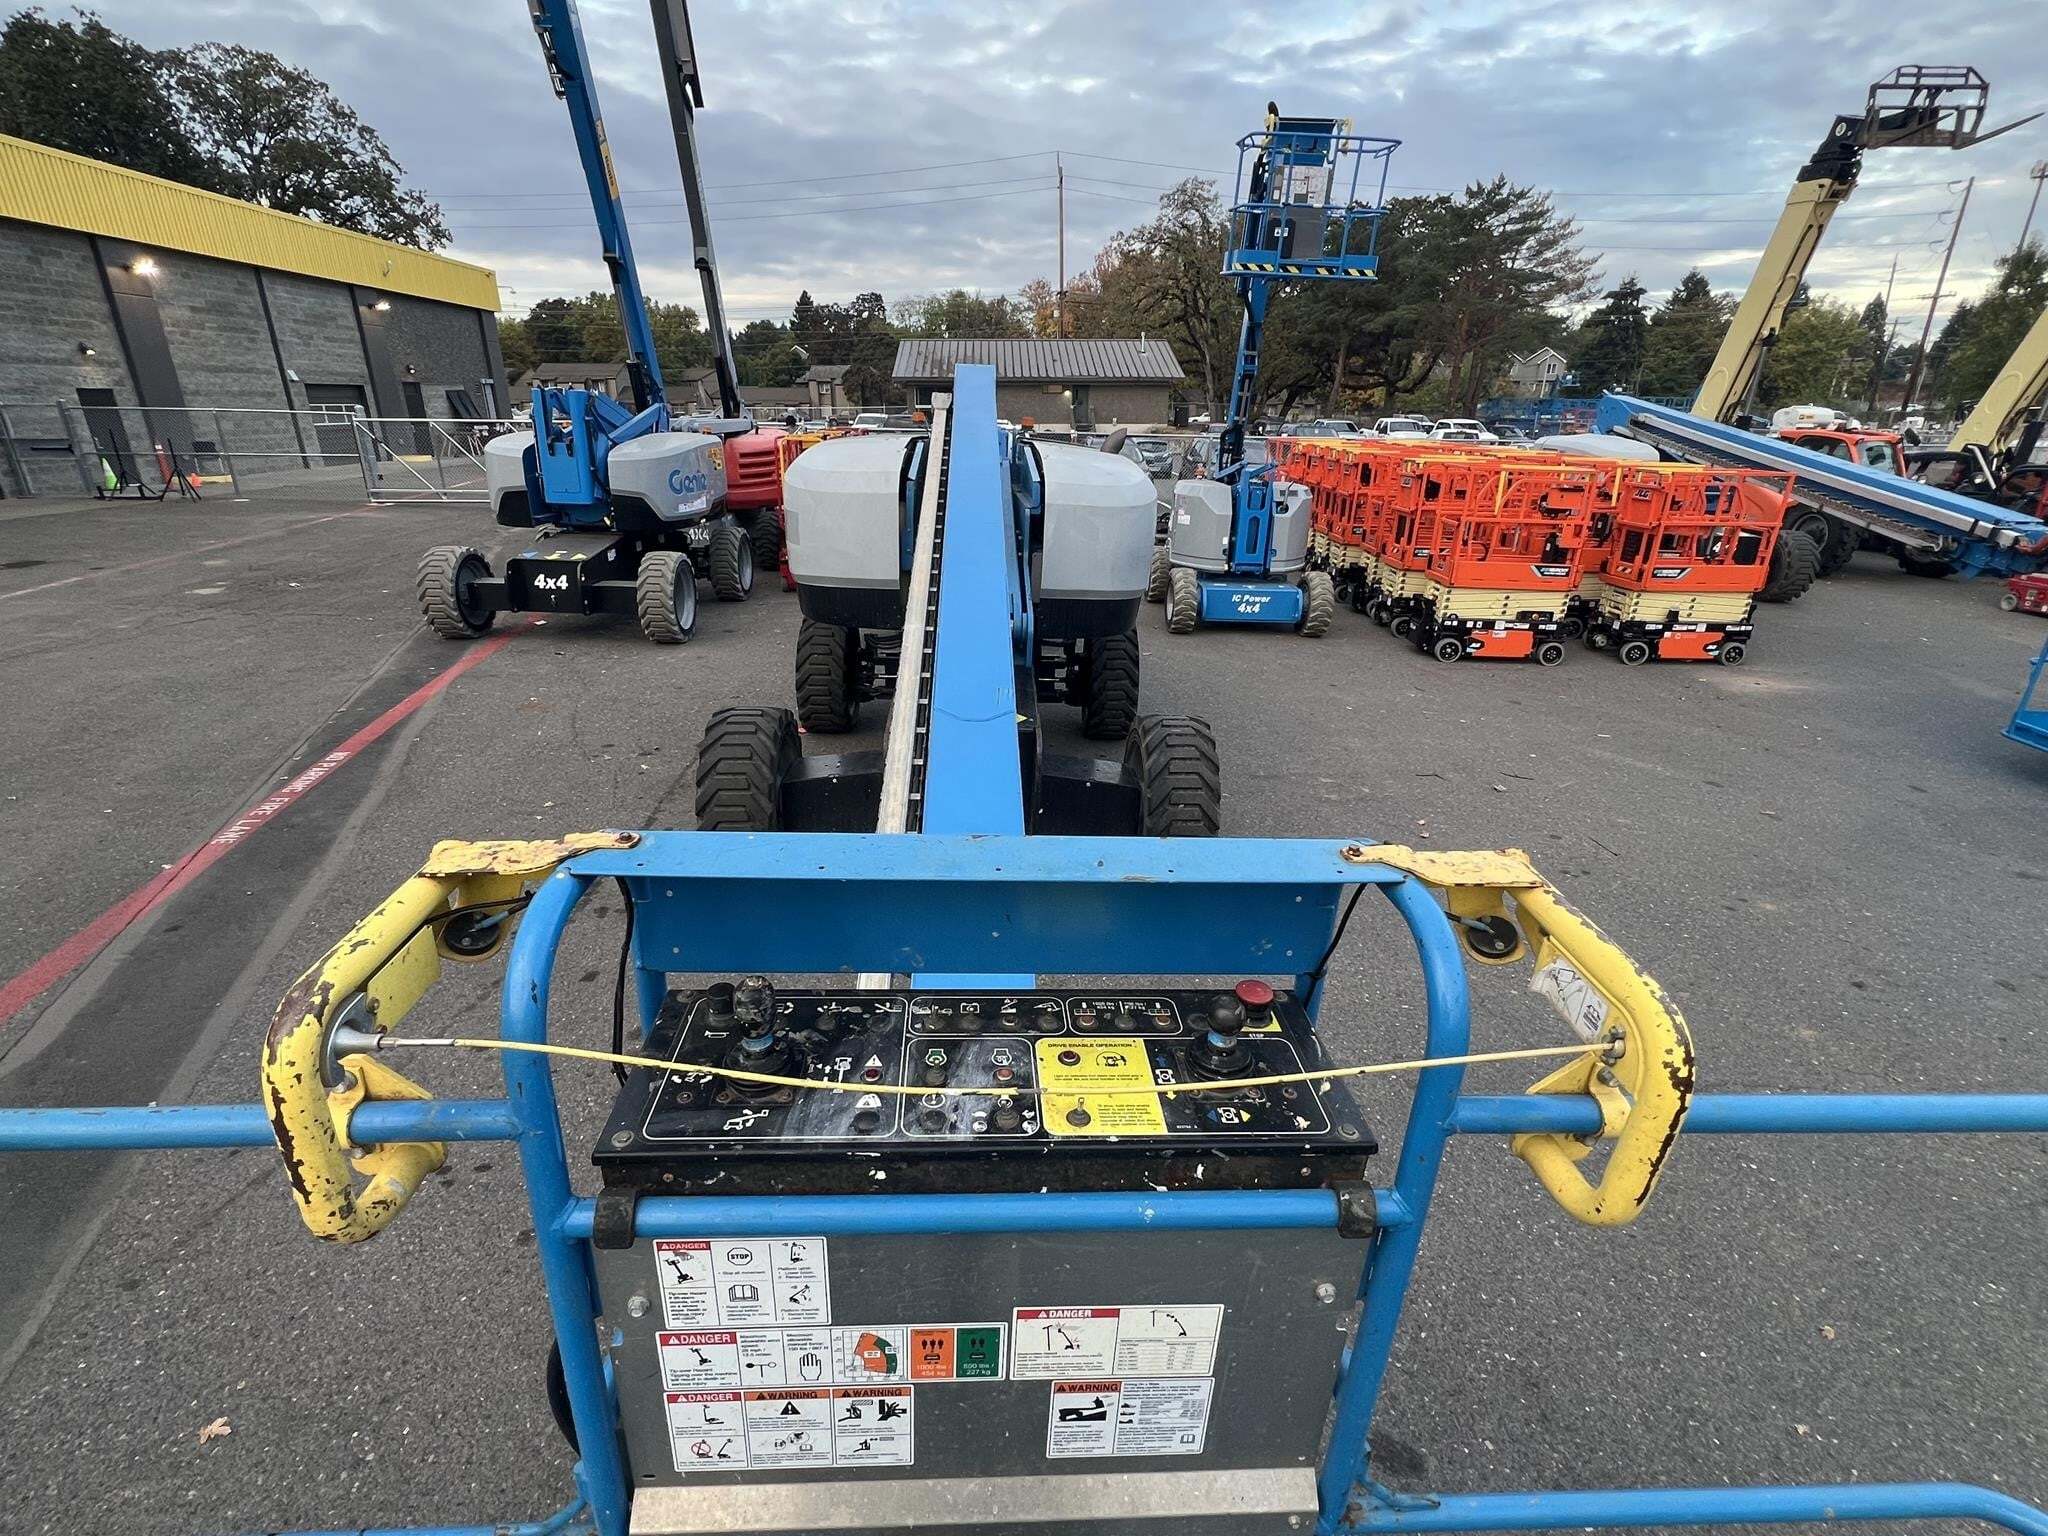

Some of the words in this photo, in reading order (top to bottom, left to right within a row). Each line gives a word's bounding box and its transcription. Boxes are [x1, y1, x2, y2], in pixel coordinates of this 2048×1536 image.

[669, 469, 708, 495] Genie
[1635, 489, 1649, 498] JLG
[534, 574, 568, 590] 4x4
[1232, 594, 1241, 602] IC
[1243, 594, 1271, 602] Power
[1237, 603, 1261, 614] 4x4
[325, 751, 351, 761] NO
[282, 762, 337, 793] PARKING
[248, 797, 289, 816] FIRE
[211, 819, 261, 844] LANE
[1049, 1310, 1092, 1318] DANGER
[681, 1334, 731, 1344] DANGER
[1068, 1383, 1118, 1392] WARNING
[688, 1393, 733, 1401] DANGER
[768, 1391, 818, 1399] WARNING
[853, 1389, 902, 1397] WARNING
